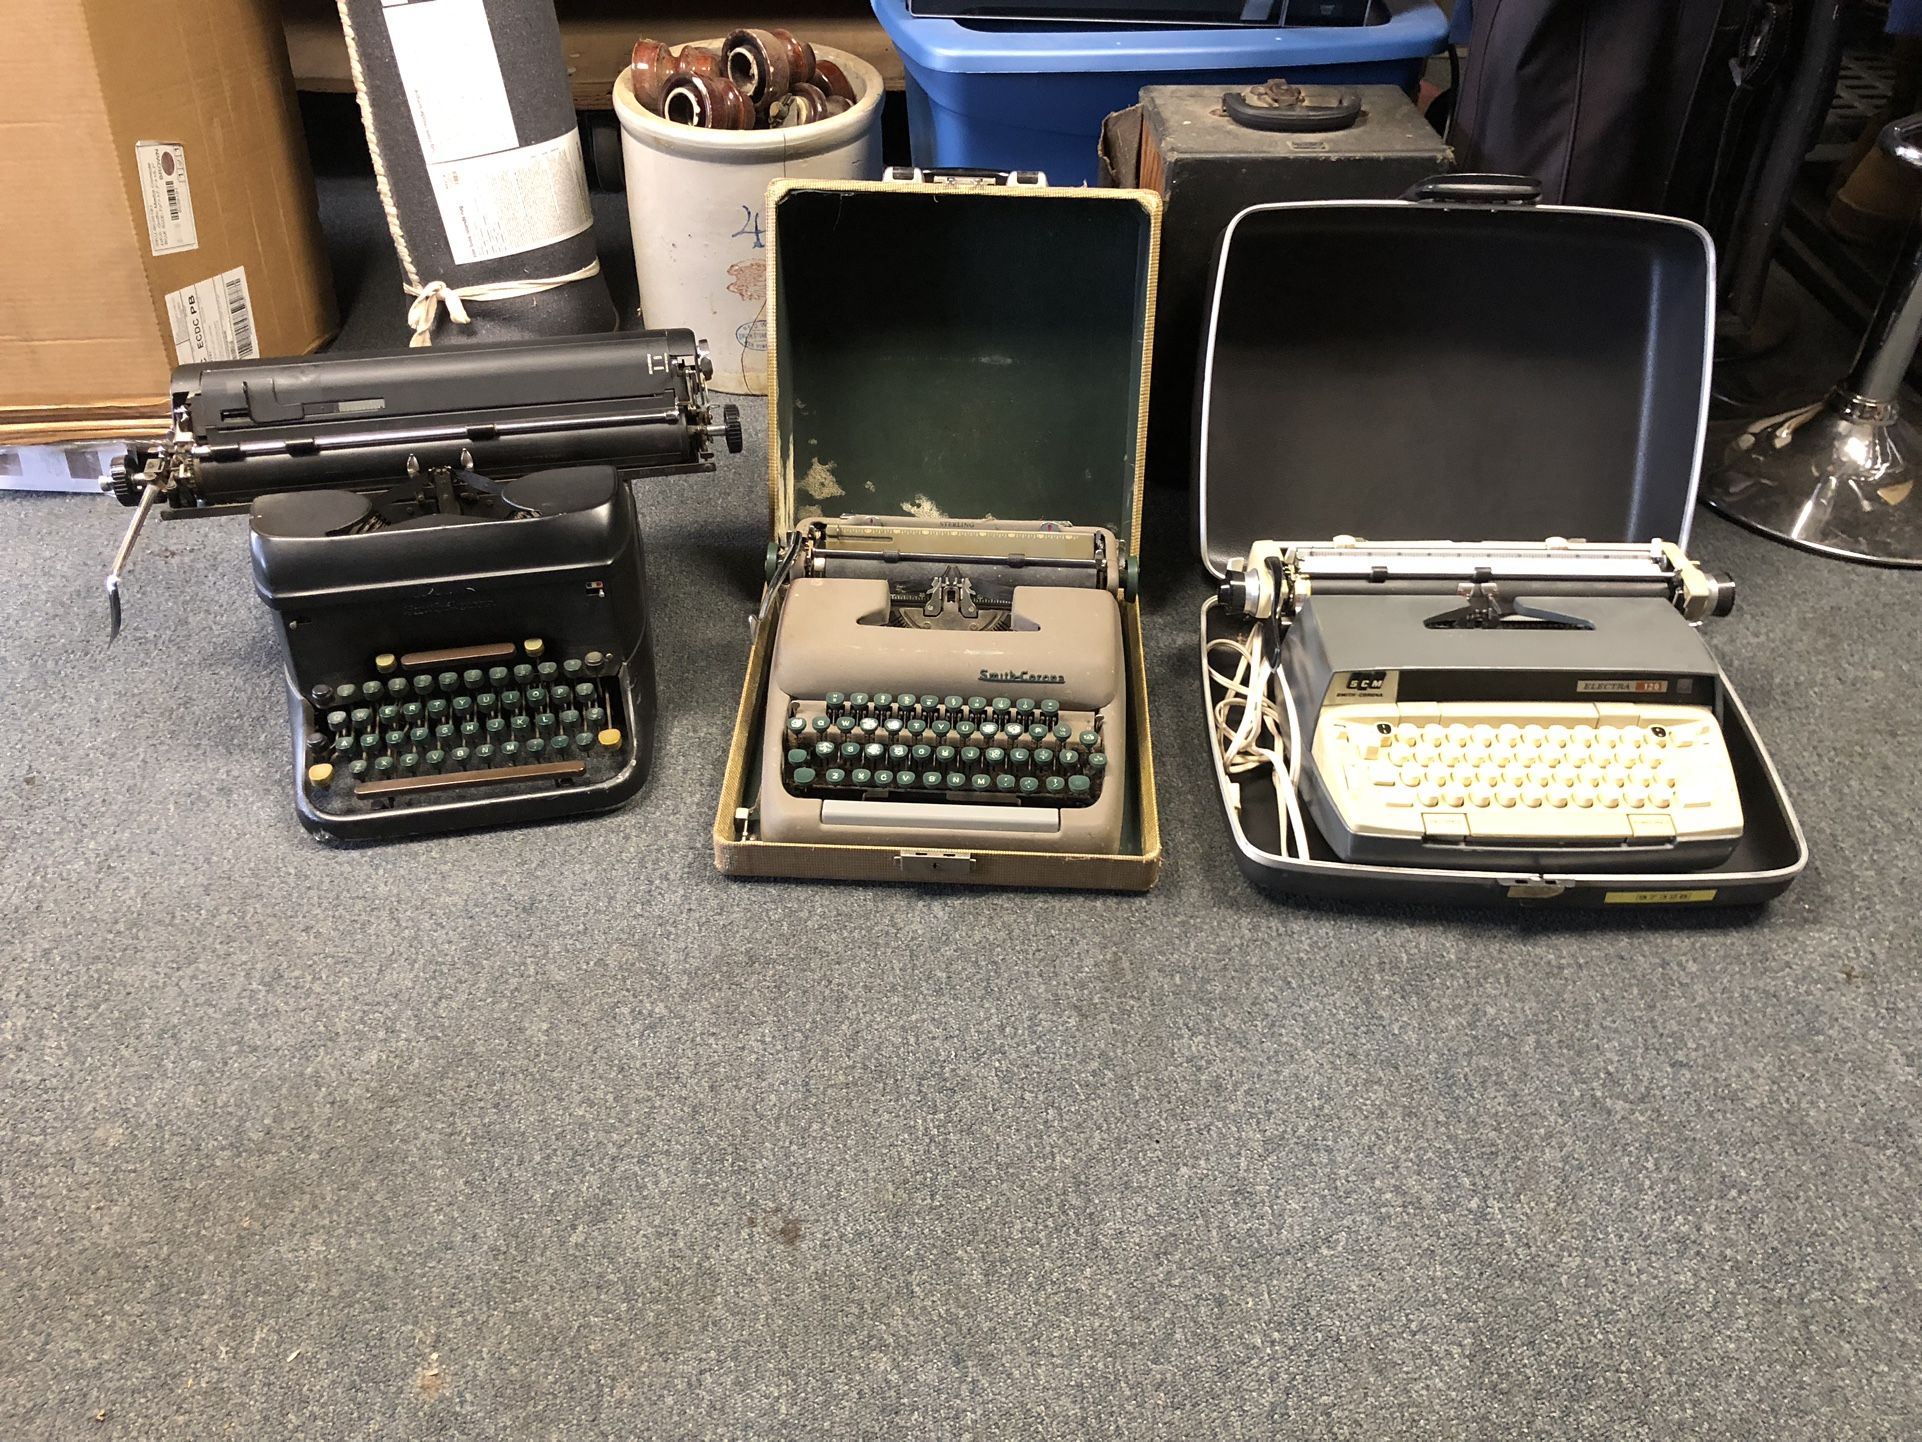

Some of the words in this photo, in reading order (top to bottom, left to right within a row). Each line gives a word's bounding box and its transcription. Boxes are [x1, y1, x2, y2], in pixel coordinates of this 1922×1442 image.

[731, 205, 767, 249] 4
[188, 295, 197, 315] PB
[192, 318, 204, 349] ECDC
[1349, 680, 1382, 688] SCM
[1583, 682, 1631, 690] ELECTRA
